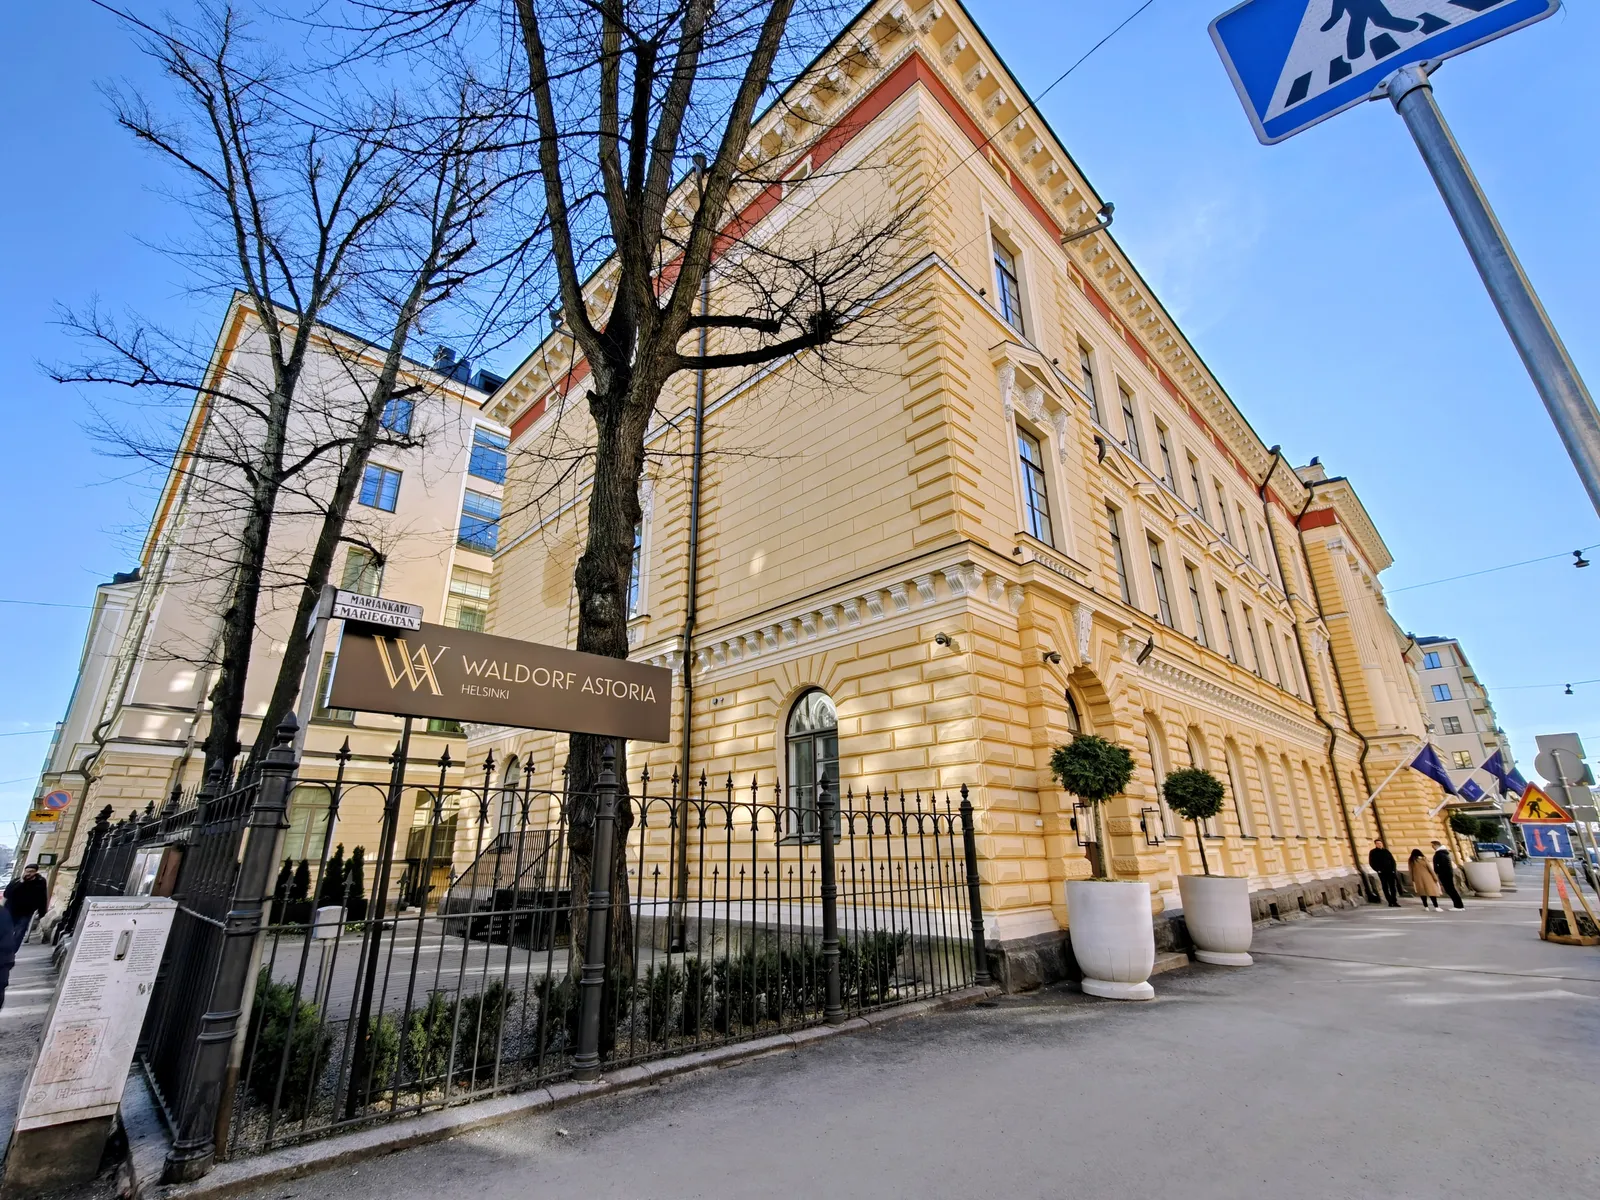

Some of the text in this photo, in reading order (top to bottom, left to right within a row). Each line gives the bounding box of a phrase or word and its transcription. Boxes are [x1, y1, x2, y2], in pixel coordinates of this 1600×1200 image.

[350, 595, 411, 615] MARIANKATU
[340, 606, 415, 627] MARIEGATAN
[462, 654, 657, 704] WALDORF ASTORIA
[461, 684, 510, 700] HELSINKI
[87, 920, 102, 928] 25.
